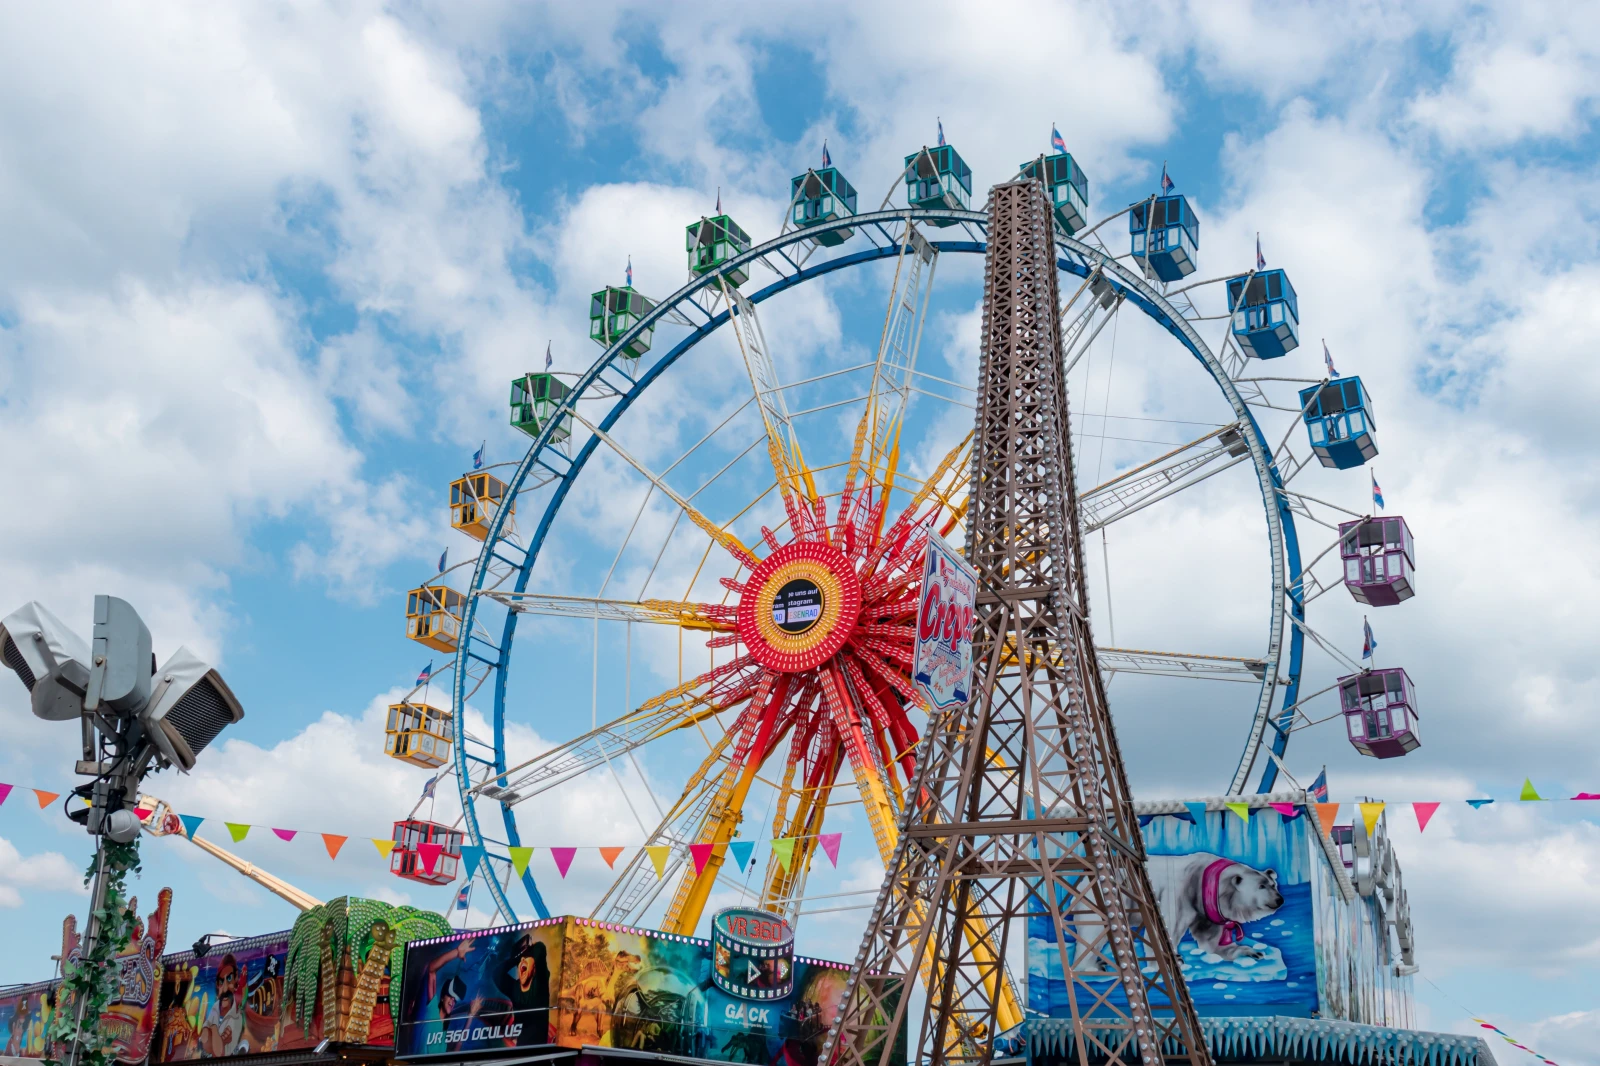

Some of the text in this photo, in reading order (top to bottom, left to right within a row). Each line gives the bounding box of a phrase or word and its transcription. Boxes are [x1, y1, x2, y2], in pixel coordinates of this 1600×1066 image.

[726, 915, 748, 937] VR
[725, 1002, 770, 1024] GACK
[426, 1024, 523, 1044] VR 360 OCULUS
